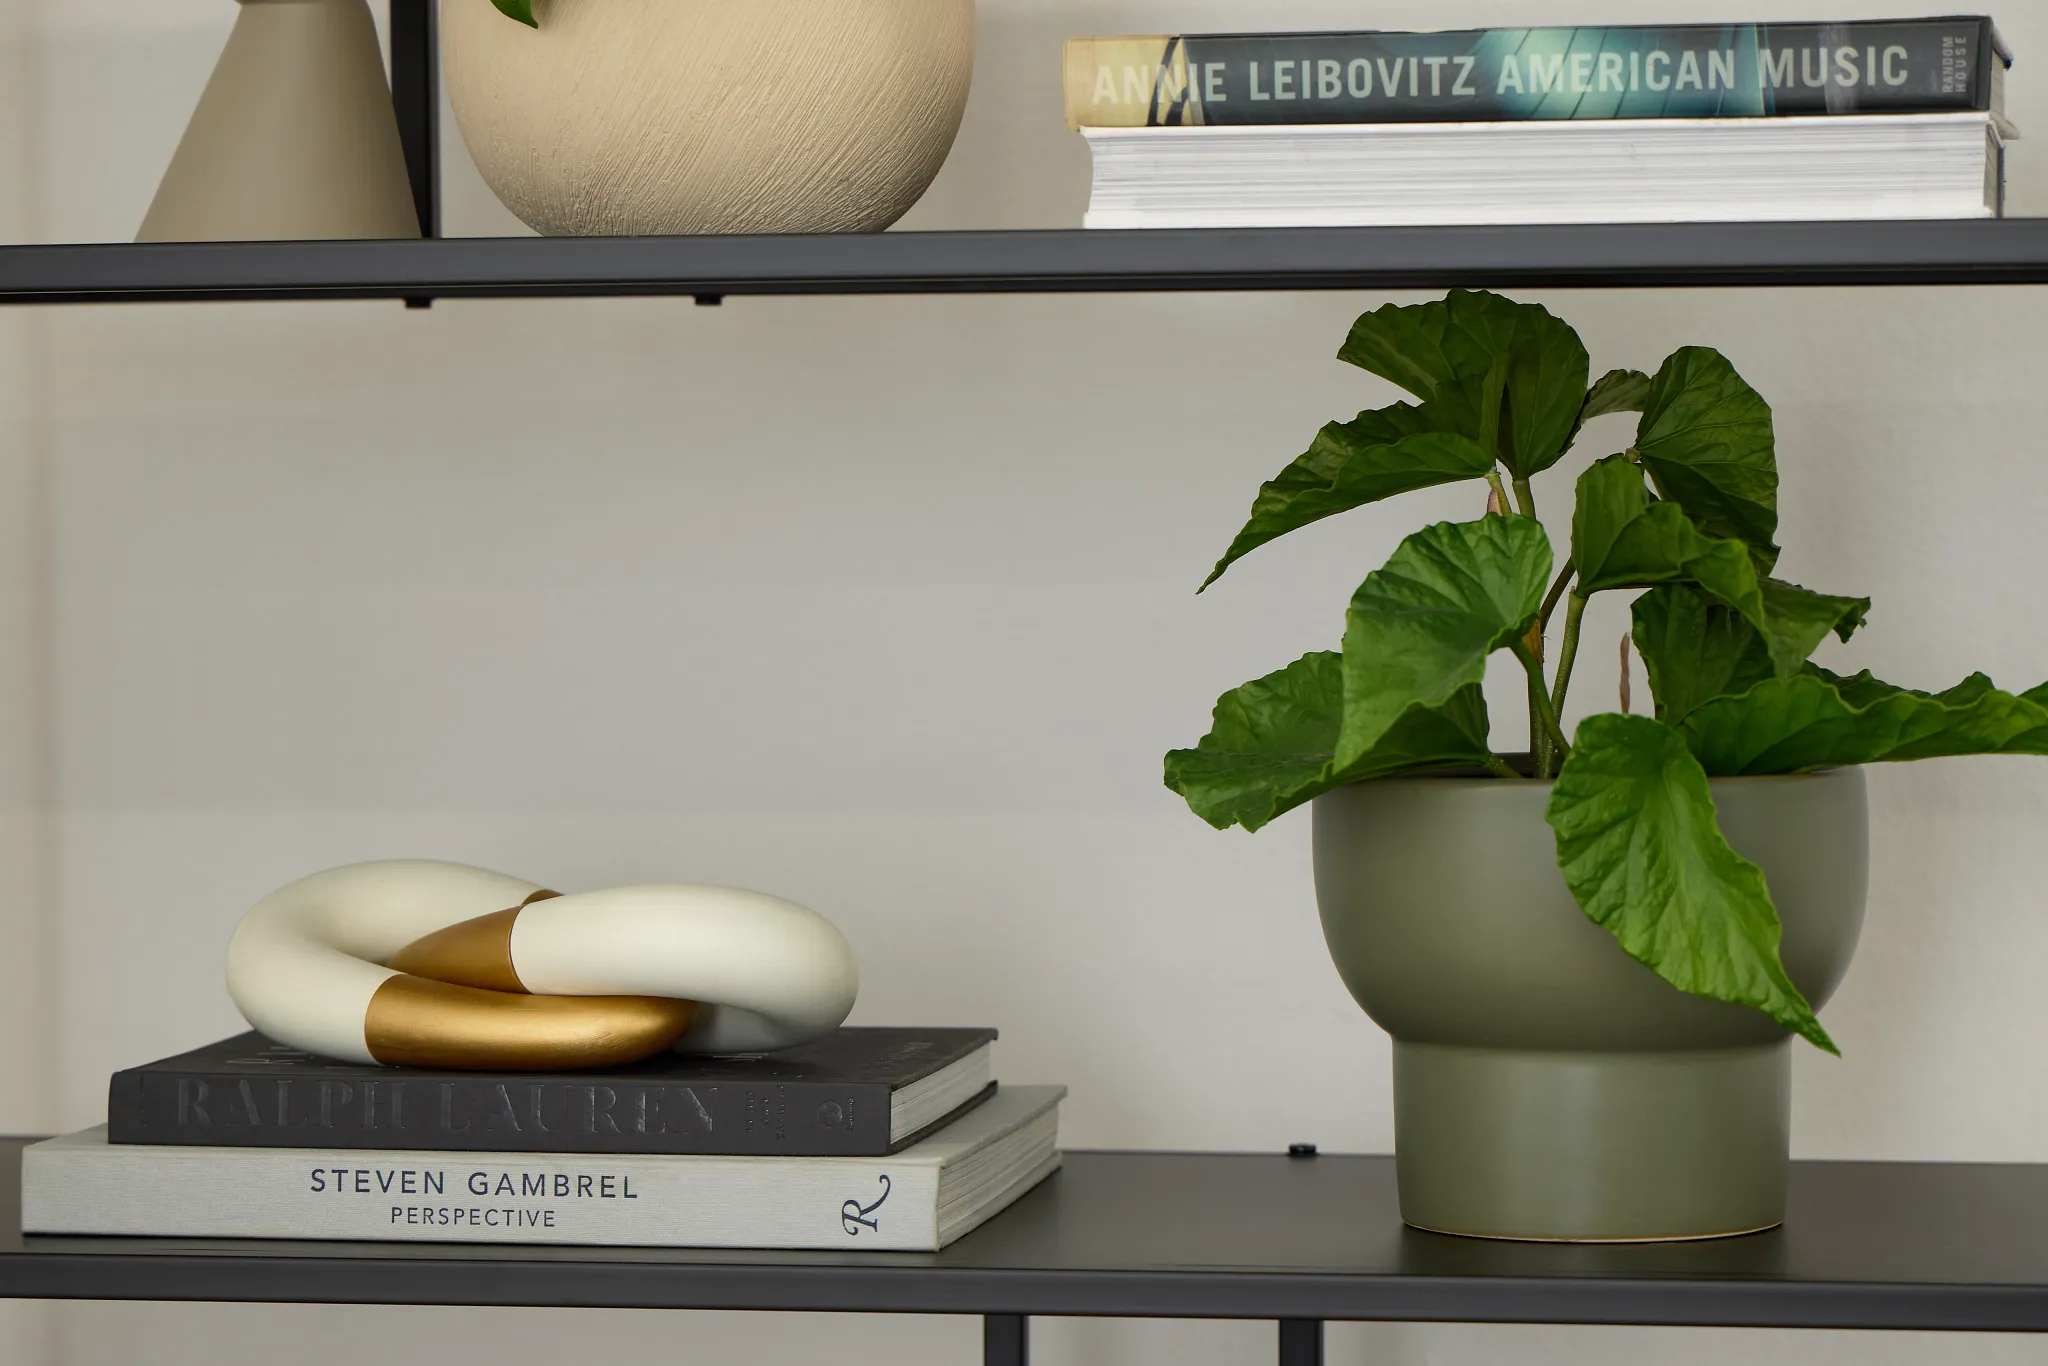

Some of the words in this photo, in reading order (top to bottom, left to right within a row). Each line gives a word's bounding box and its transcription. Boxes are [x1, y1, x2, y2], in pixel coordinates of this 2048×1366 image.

[1091, 61, 1227, 105] ANNIE
[1249, 55, 1476, 100] LEIBOVITZ
[1496, 48, 1735, 95] AMERICAN
[1759, 44, 1909, 89] MUSIC
[1942, 36, 1954, 93] RANDOM
[1955, 36, 1967, 93] HOUSE
[176, 1078, 407, 1131] RALPH
[439, 1081, 719, 1135] LAUREN
[310, 1168, 445, 1195] STEVEN
[467, 1170, 639, 1200] GAMBREL
[391, 1206, 556, 1228] PERSPECTIVE
